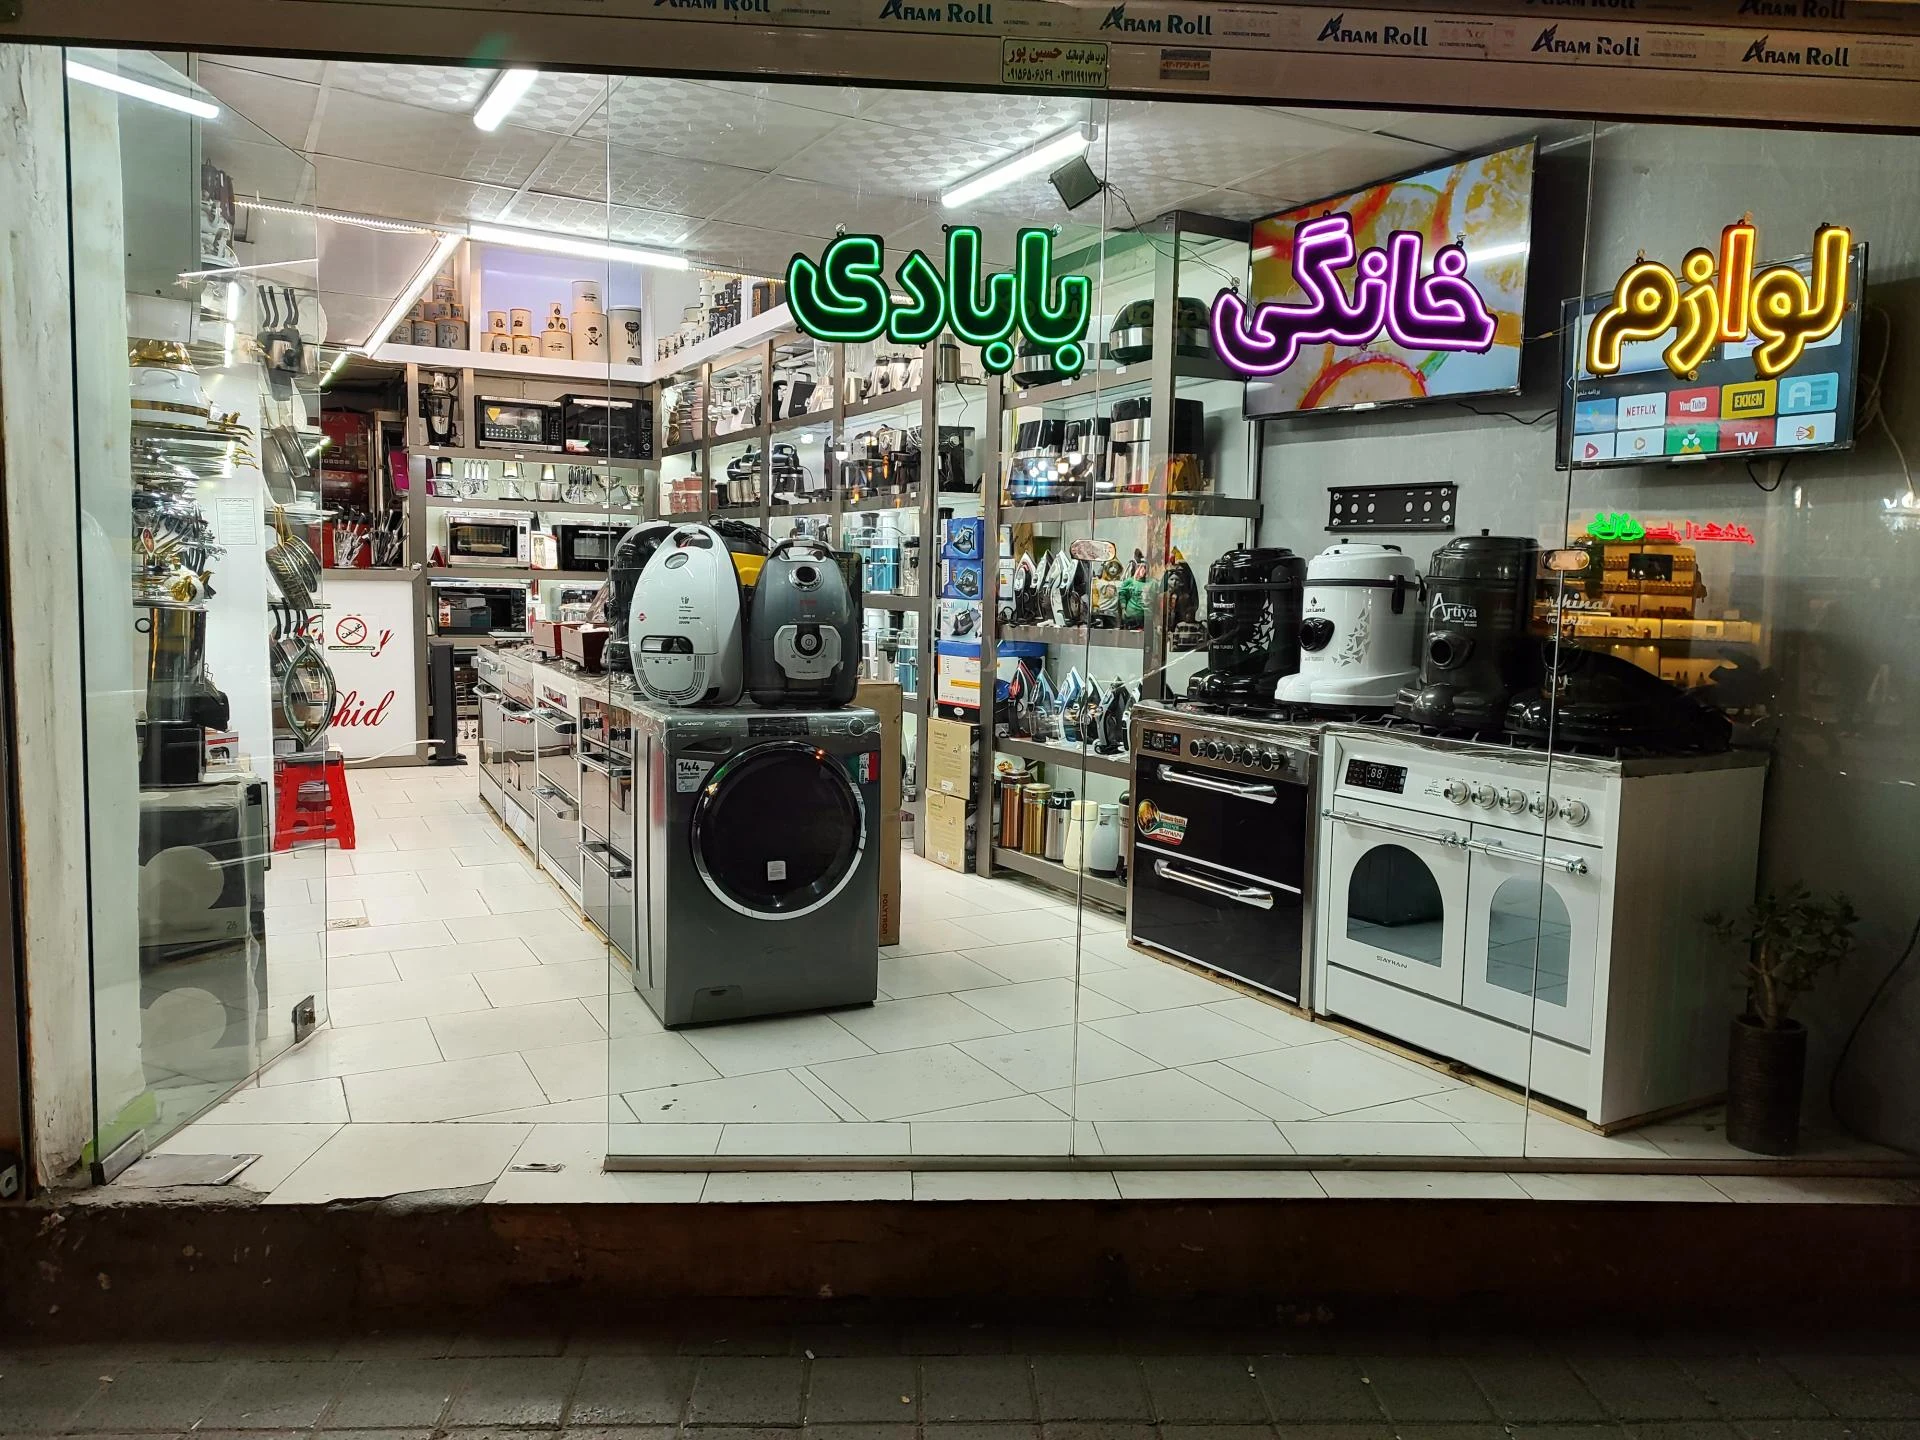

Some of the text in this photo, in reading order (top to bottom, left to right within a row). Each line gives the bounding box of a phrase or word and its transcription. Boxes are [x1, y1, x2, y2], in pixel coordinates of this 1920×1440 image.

[654, 0, 717, 9] RAM
[947, 3, 993, 24] Roll
[1167, 14, 1213, 36] Roll
[1383, 26, 1429, 47] Roll
[1008, 46, 1027, 64] پور
[1028, 47, 1063, 63] حسین
[1806, 47, 1849, 67] Roll
[785, 211, 1851, 379] لوازم خانگی بابادی
[1626, 404, 1657, 417] NETFLIX
[1679, 396, 1707, 414] YouTube
[1735, 431, 1759, 447] TW
[1430, 593, 1477, 622] Artiya
[678, 762, 700, 772] 144
